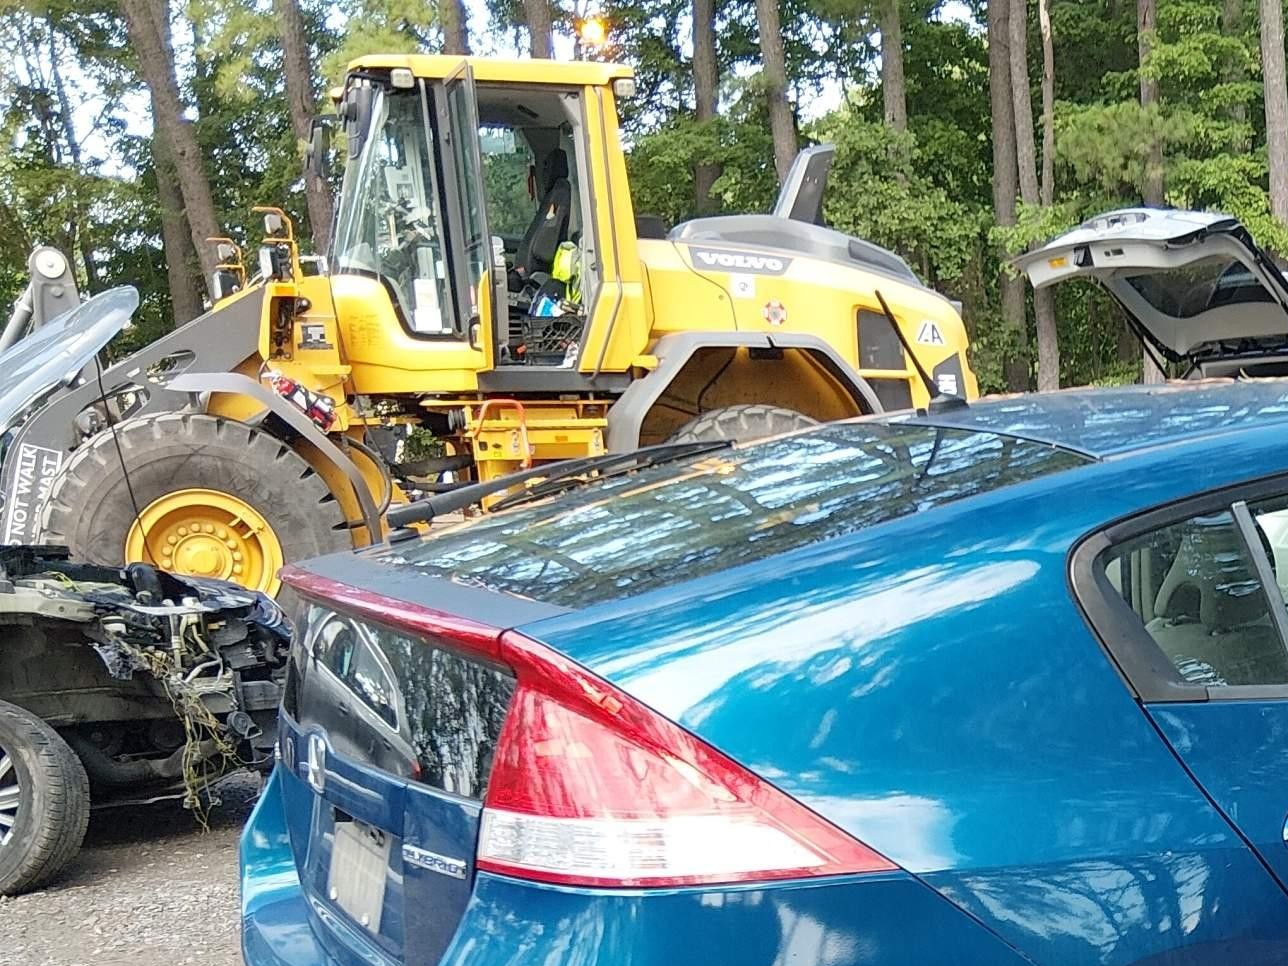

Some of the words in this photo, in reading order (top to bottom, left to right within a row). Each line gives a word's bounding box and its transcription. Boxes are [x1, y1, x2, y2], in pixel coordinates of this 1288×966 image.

[697, 251, 783, 271] VOLVO
[18, 447, 37, 494] WALK
[37, 456, 57, 499] MAST
[11, 496, 29, 536] NOT
